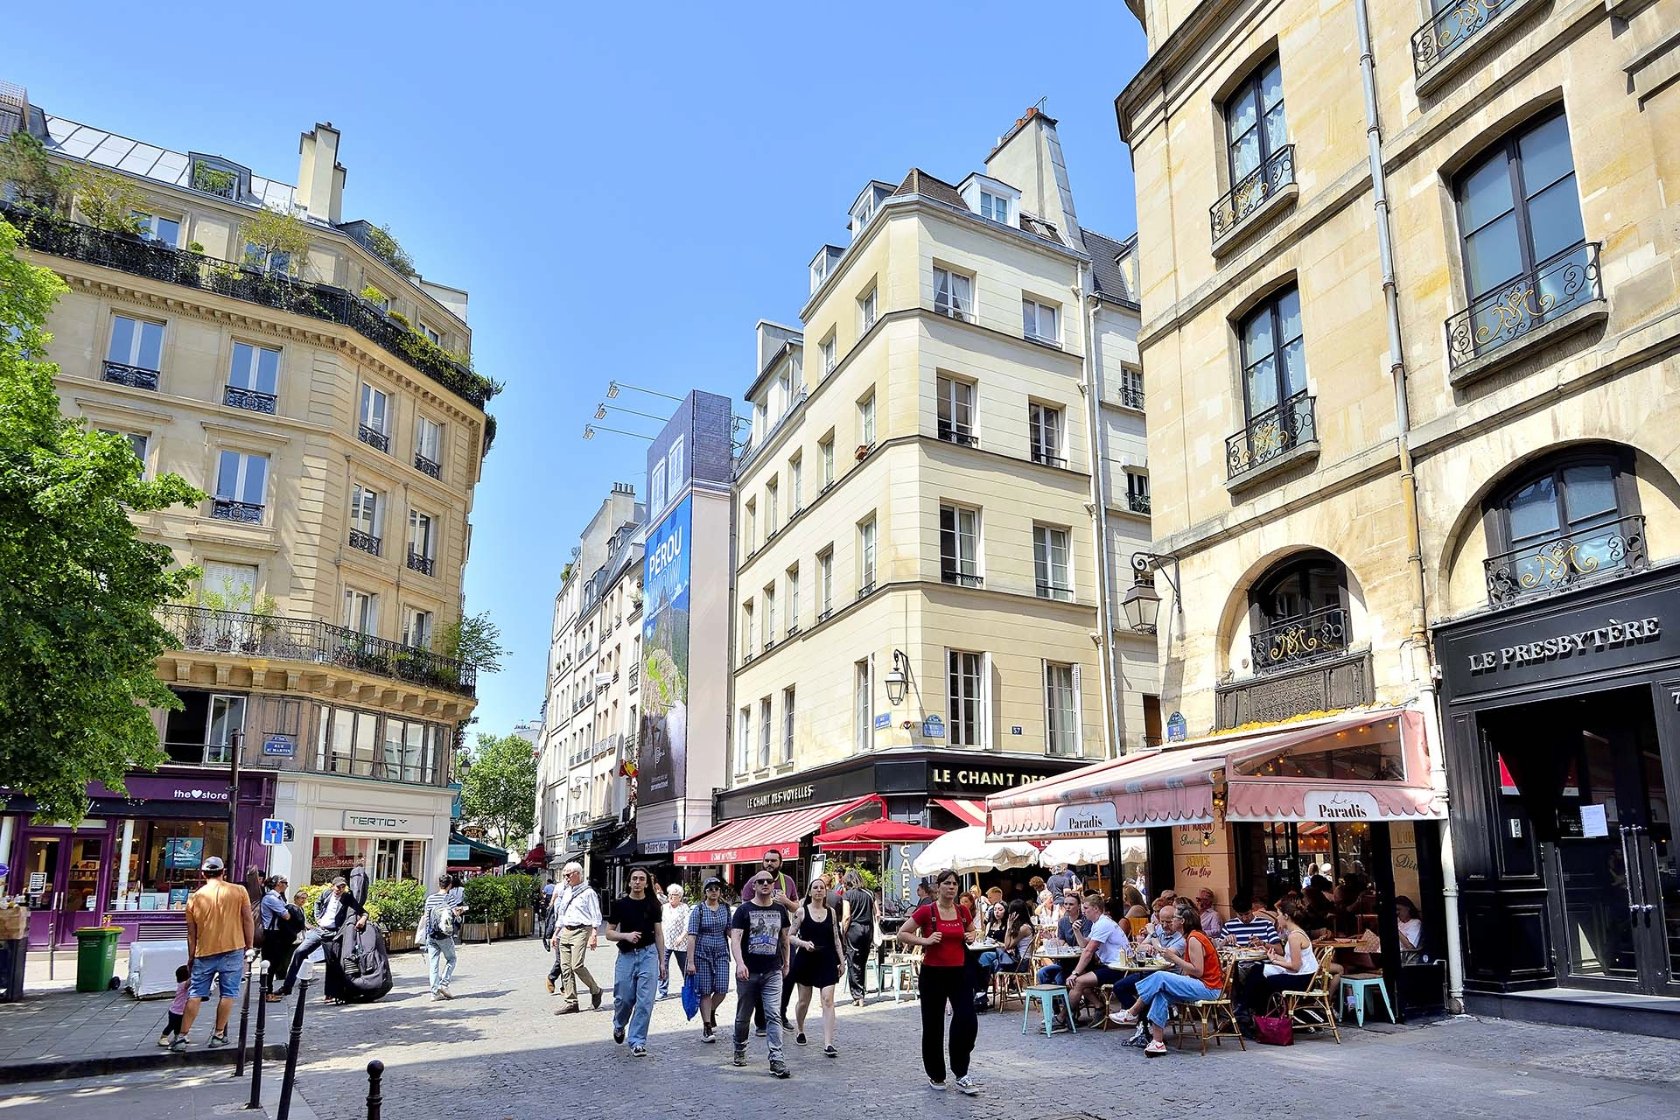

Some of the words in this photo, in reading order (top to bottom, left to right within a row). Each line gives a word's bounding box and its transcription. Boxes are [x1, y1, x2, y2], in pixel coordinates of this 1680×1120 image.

[649, 526, 682, 581] PÉROU
[1468, 651, 1497, 671] LE
[1500, 617, 1661, 664] PRESBYTÈRE
[933, 769, 951, 782] LE
[957, 770, 1015, 786] CHANT
[174, 789, 191, 798] the
[201, 791, 228, 800] store
[747, 798, 753, 808] LE
[753, 794, 771, 807] CHANT
[783, 785, 814, 801] VOYELLES
[1331, 793, 1352, 804] Le
[1319, 804, 1367, 818] Paradis
[350, 816, 396, 827] TERTIO
[1069, 815, 1103, 829] Paradis
[900, 845, 912, 900] CAFÉ
